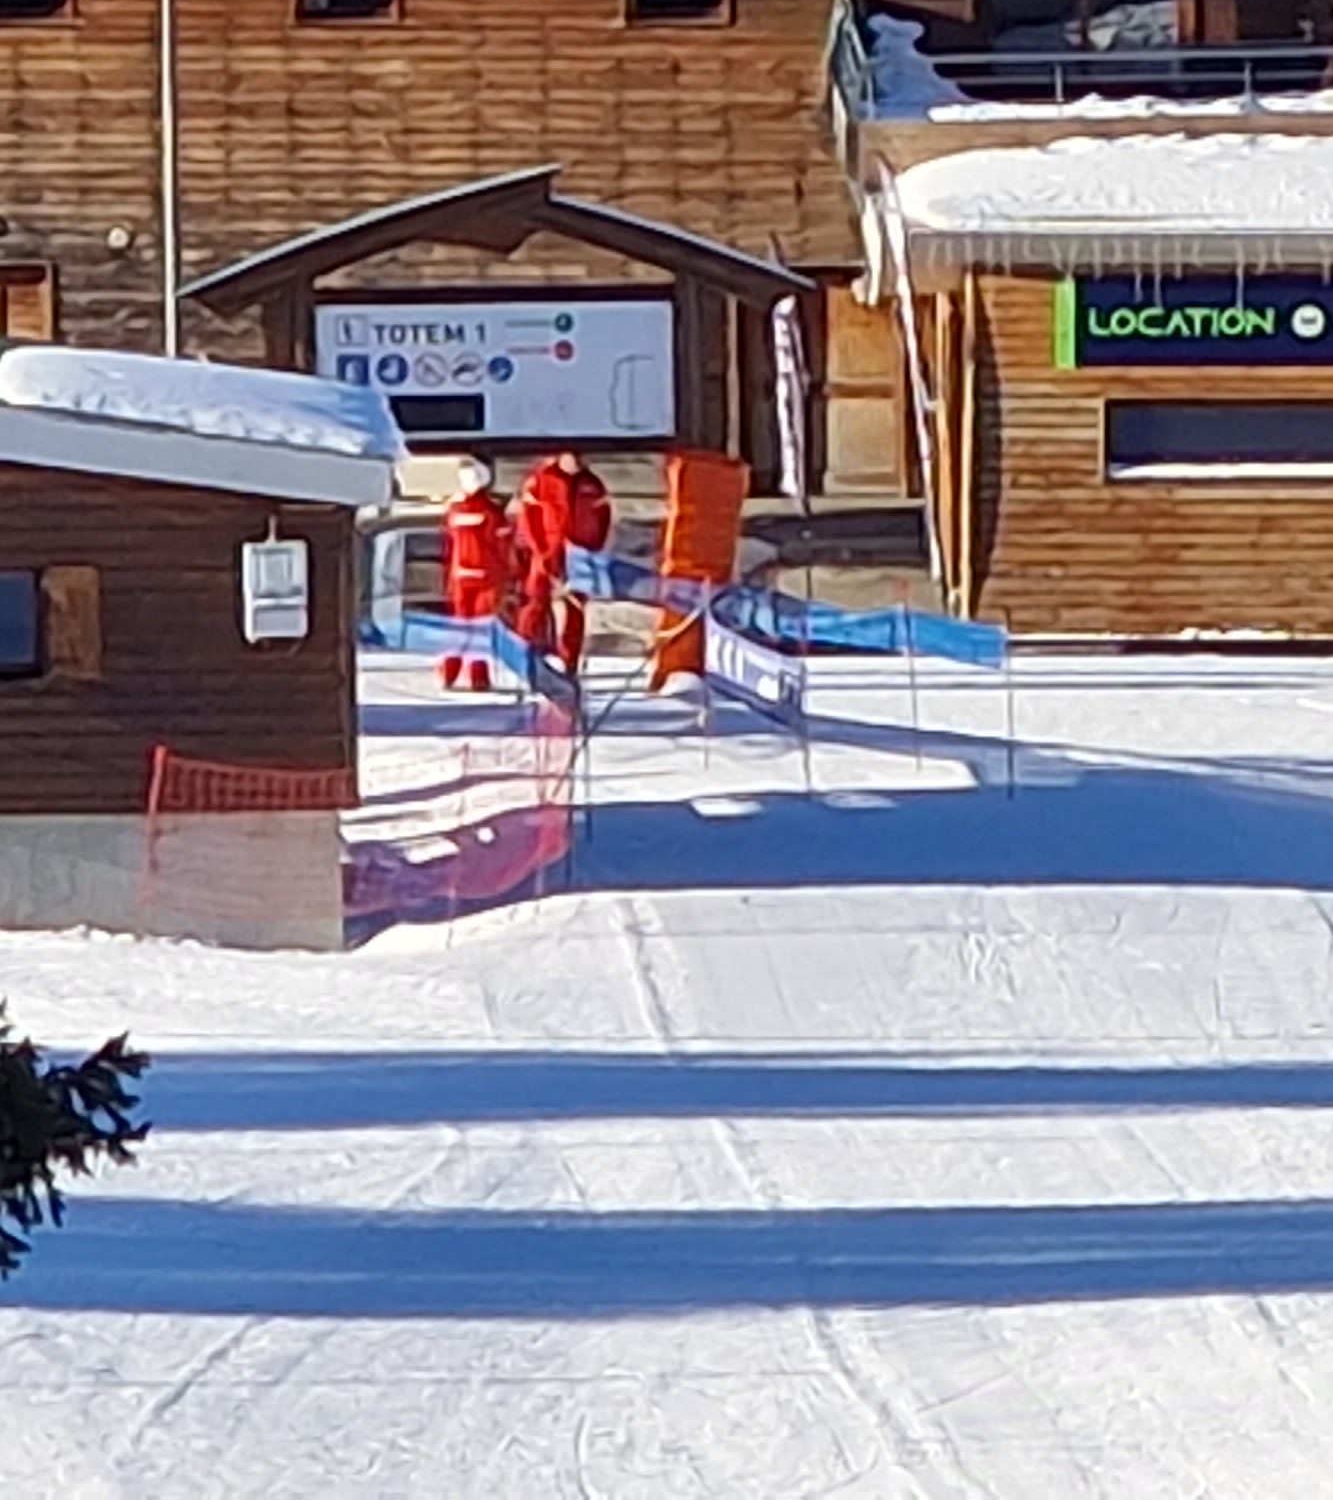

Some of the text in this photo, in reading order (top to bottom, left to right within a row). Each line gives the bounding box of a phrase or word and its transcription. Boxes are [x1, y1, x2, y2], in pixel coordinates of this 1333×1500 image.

[372, 322, 487, 345] TOTEM 1
[1088, 306, 1276, 337] LOCATION
